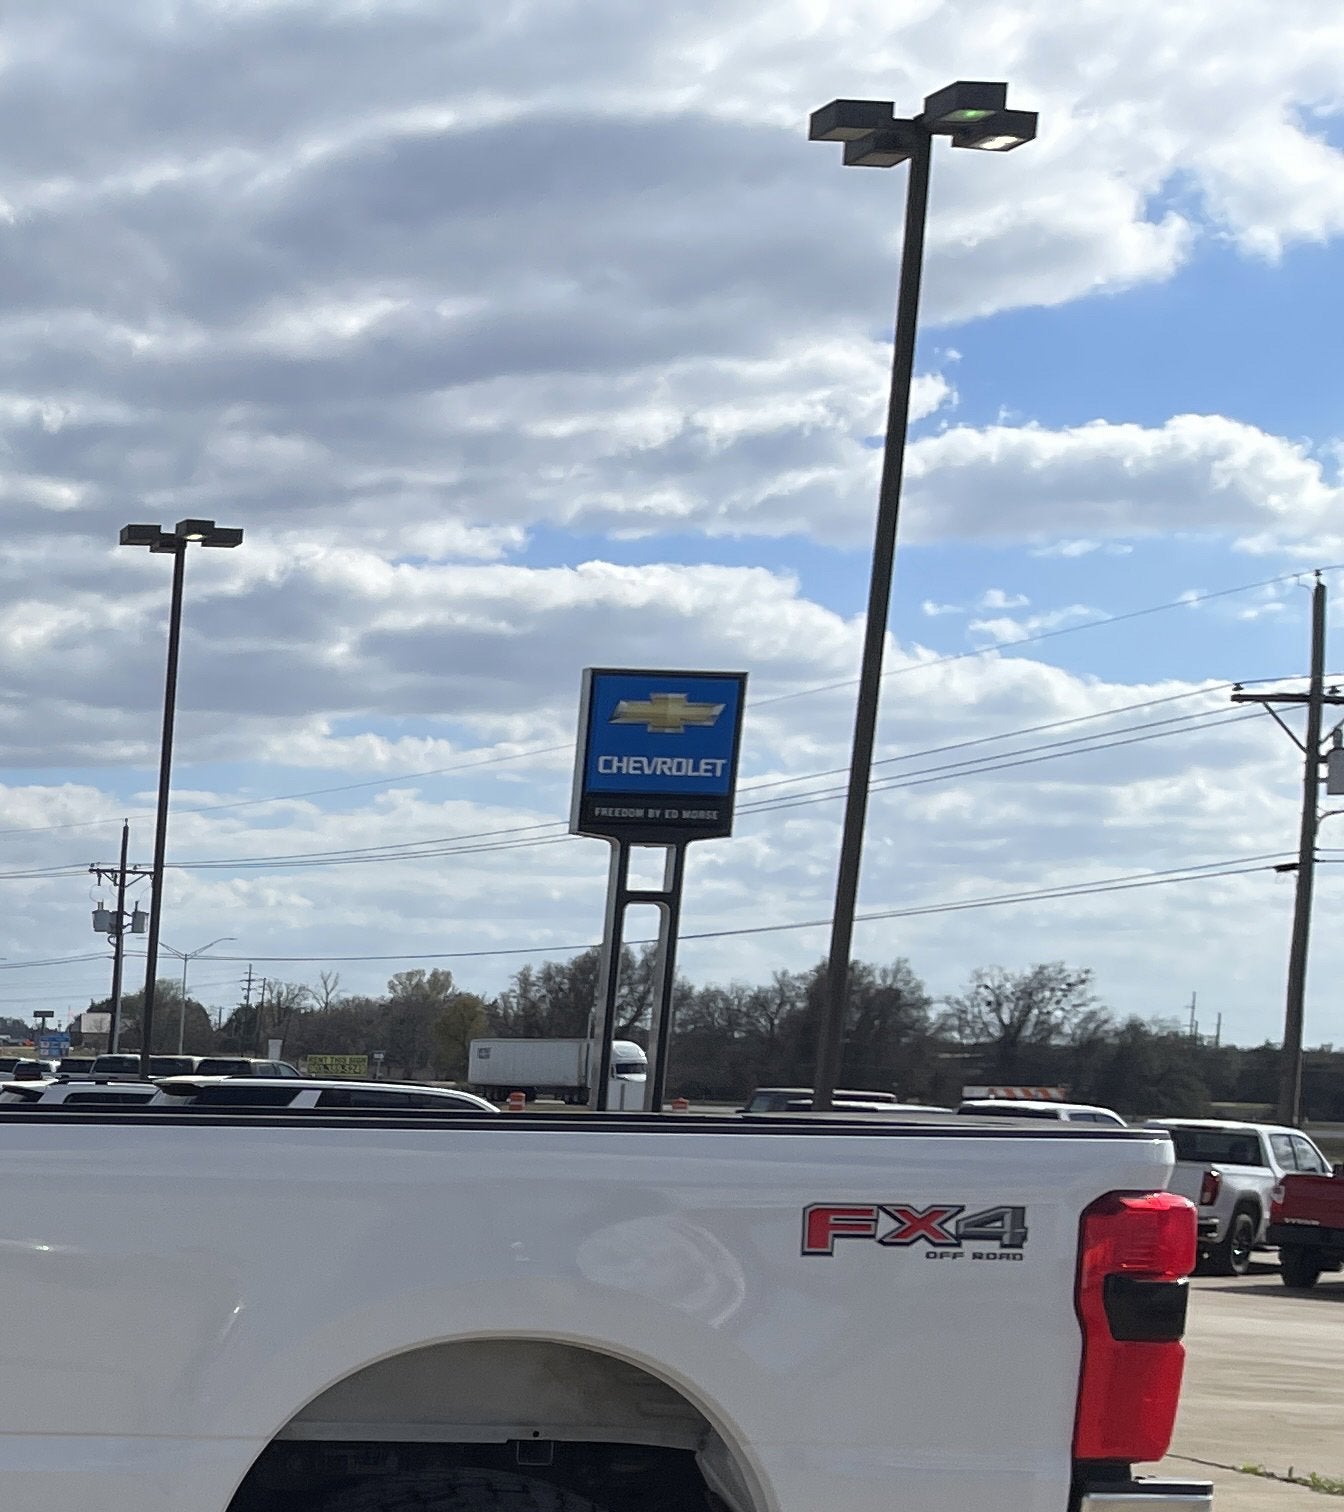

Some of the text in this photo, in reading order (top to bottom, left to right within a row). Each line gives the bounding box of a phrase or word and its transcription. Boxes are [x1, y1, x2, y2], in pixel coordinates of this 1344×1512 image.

[598, 755, 727, 777] CHEVROLET
[801, 1203, 1028, 1257] FX4
[925, 1250, 1024, 1262] OFF ROAD
